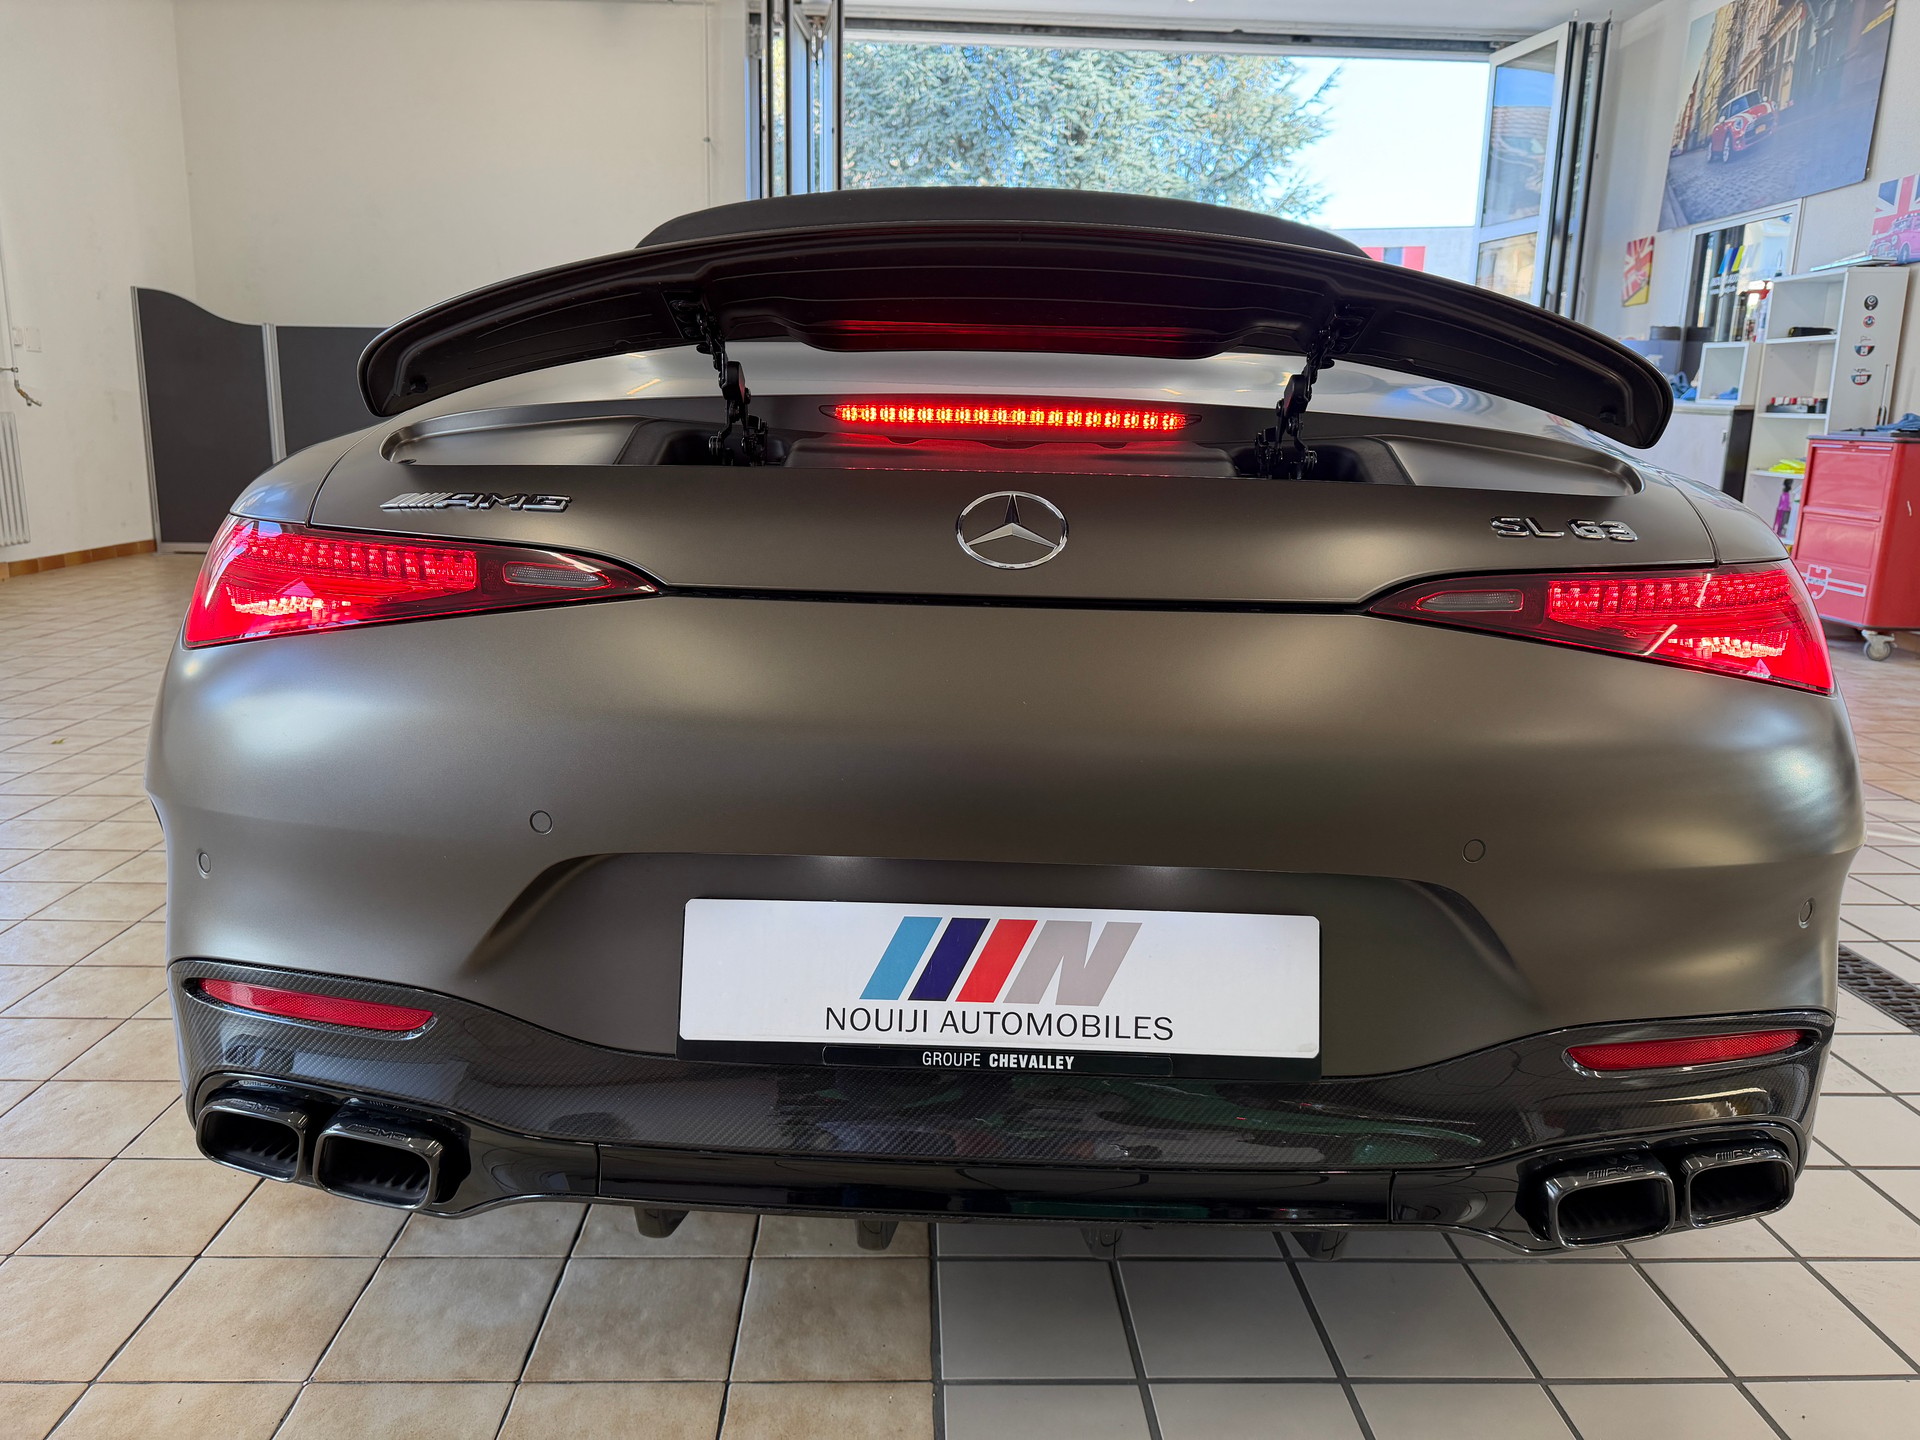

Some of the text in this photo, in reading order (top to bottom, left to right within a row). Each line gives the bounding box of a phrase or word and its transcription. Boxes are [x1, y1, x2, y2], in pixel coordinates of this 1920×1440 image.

[434, 492, 572, 512] AMG
[1489, 516, 1639, 542] SL 63
[825, 1007, 1174, 1041] NOUIJI AUTOMOBILES
[922, 1051, 1075, 1070] GROUPE CHEVALLEY
